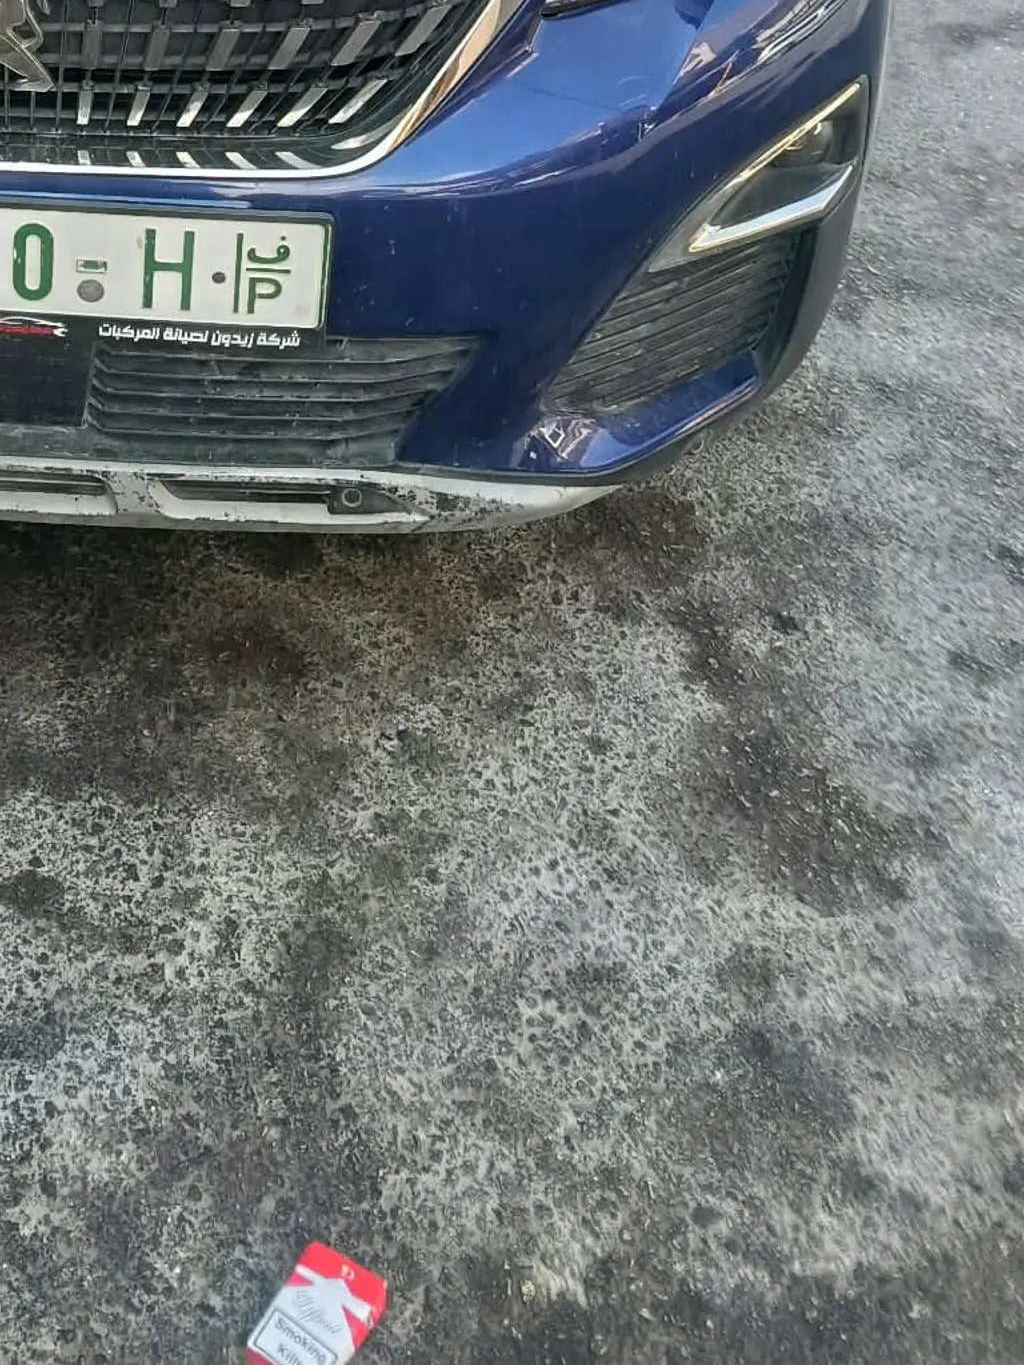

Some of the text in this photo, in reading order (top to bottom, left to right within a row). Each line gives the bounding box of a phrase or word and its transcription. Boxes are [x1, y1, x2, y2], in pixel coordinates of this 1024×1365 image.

[246, 277, 282, 314] P
[98, 323, 300, 349] شركة زيدون لصيانة المركبات
[276, 1317, 327, 1365] Smoking
[277, 1343, 302, 1365] Kill
